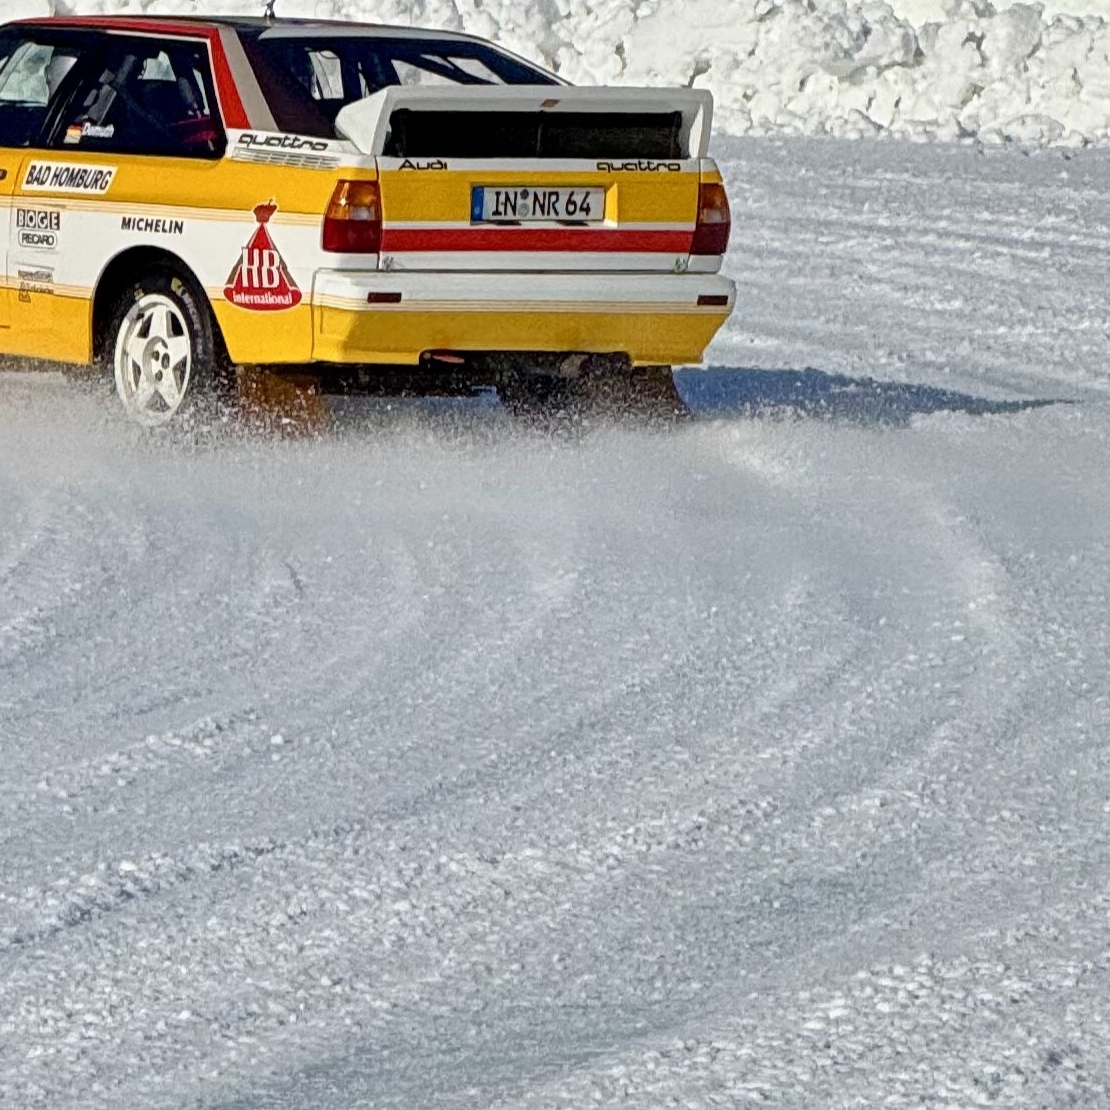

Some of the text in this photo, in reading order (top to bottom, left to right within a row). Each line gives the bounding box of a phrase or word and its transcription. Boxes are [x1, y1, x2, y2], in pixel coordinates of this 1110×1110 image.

[239, 133, 329, 152] quattro
[398, 159, 448, 171] Audi
[596, 161, 681, 172] quattro
[25, 164, 112, 191] BAD HOMBURG
[492, 190, 591, 217] IN NR 64
[17, 208, 60, 231] BOGE
[120, 216, 184, 234] MICHELIN
[21, 232, 56, 246] RECARO
[241, 247, 280, 290] HB
[232, 291, 293, 305] international
